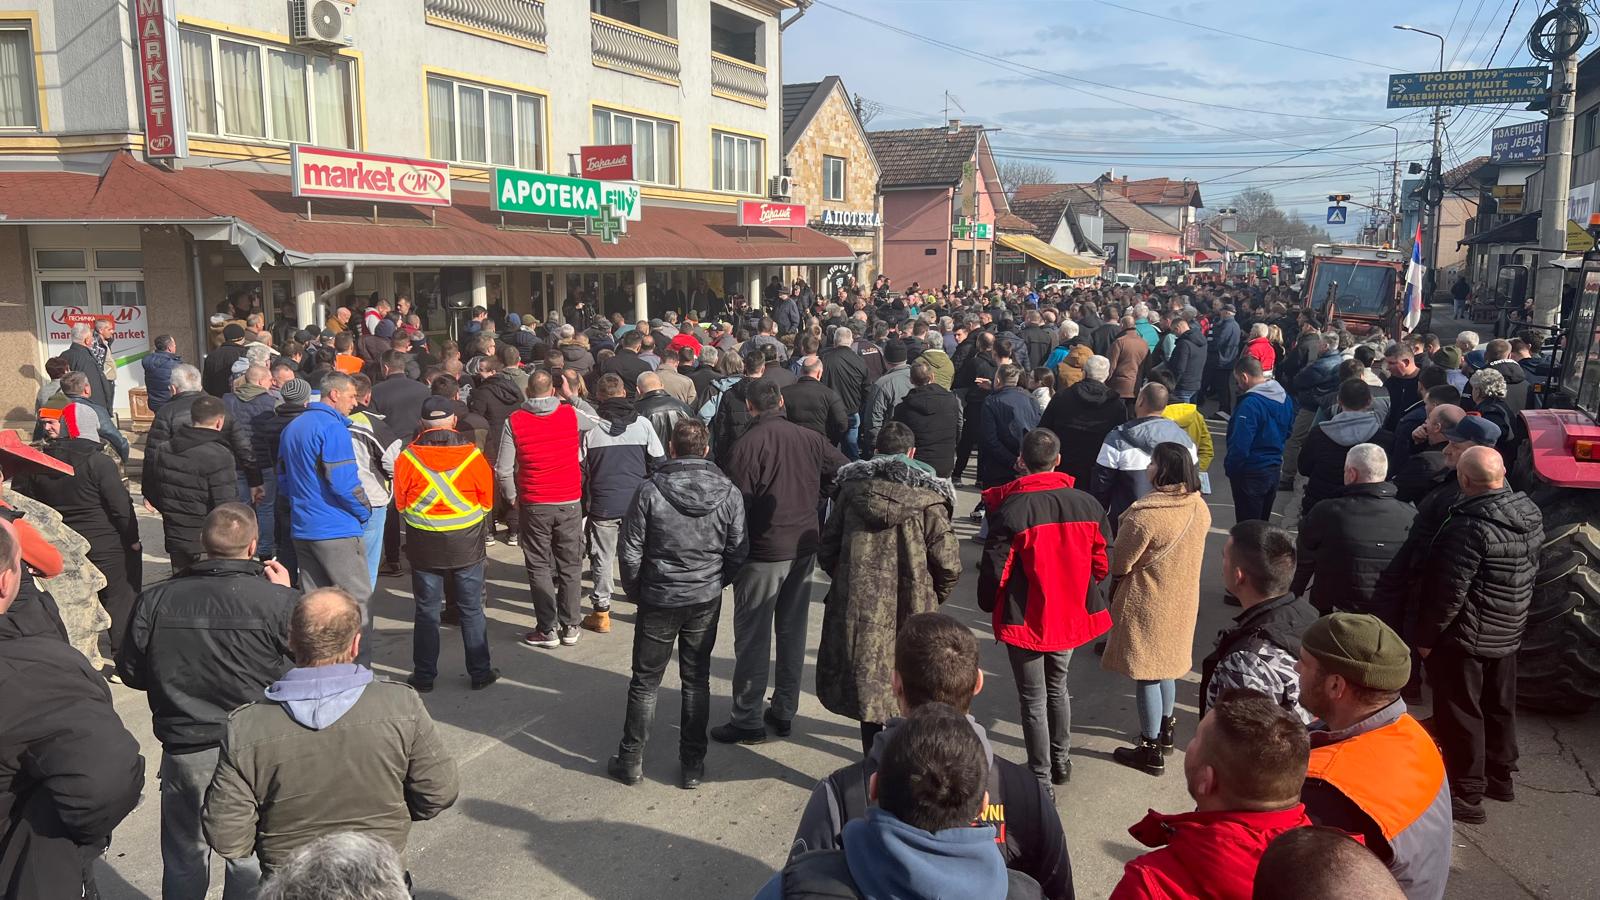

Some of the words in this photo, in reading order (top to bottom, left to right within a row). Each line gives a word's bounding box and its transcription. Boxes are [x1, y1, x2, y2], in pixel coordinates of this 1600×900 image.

[139, 0, 166, 126] MARKET
[1424, 80, 1508, 91] СТОВАРИШТЕ
[1473, 88, 1544, 98] МАТЕРИЈАЛА
[1494, 122, 1543, 139] ИЗЛЕТИШТЕ
[304, 162, 395, 192] market
[502, 178, 598, 211] APOTEKA
[825, 210, 881, 226] АПОТЕКА
